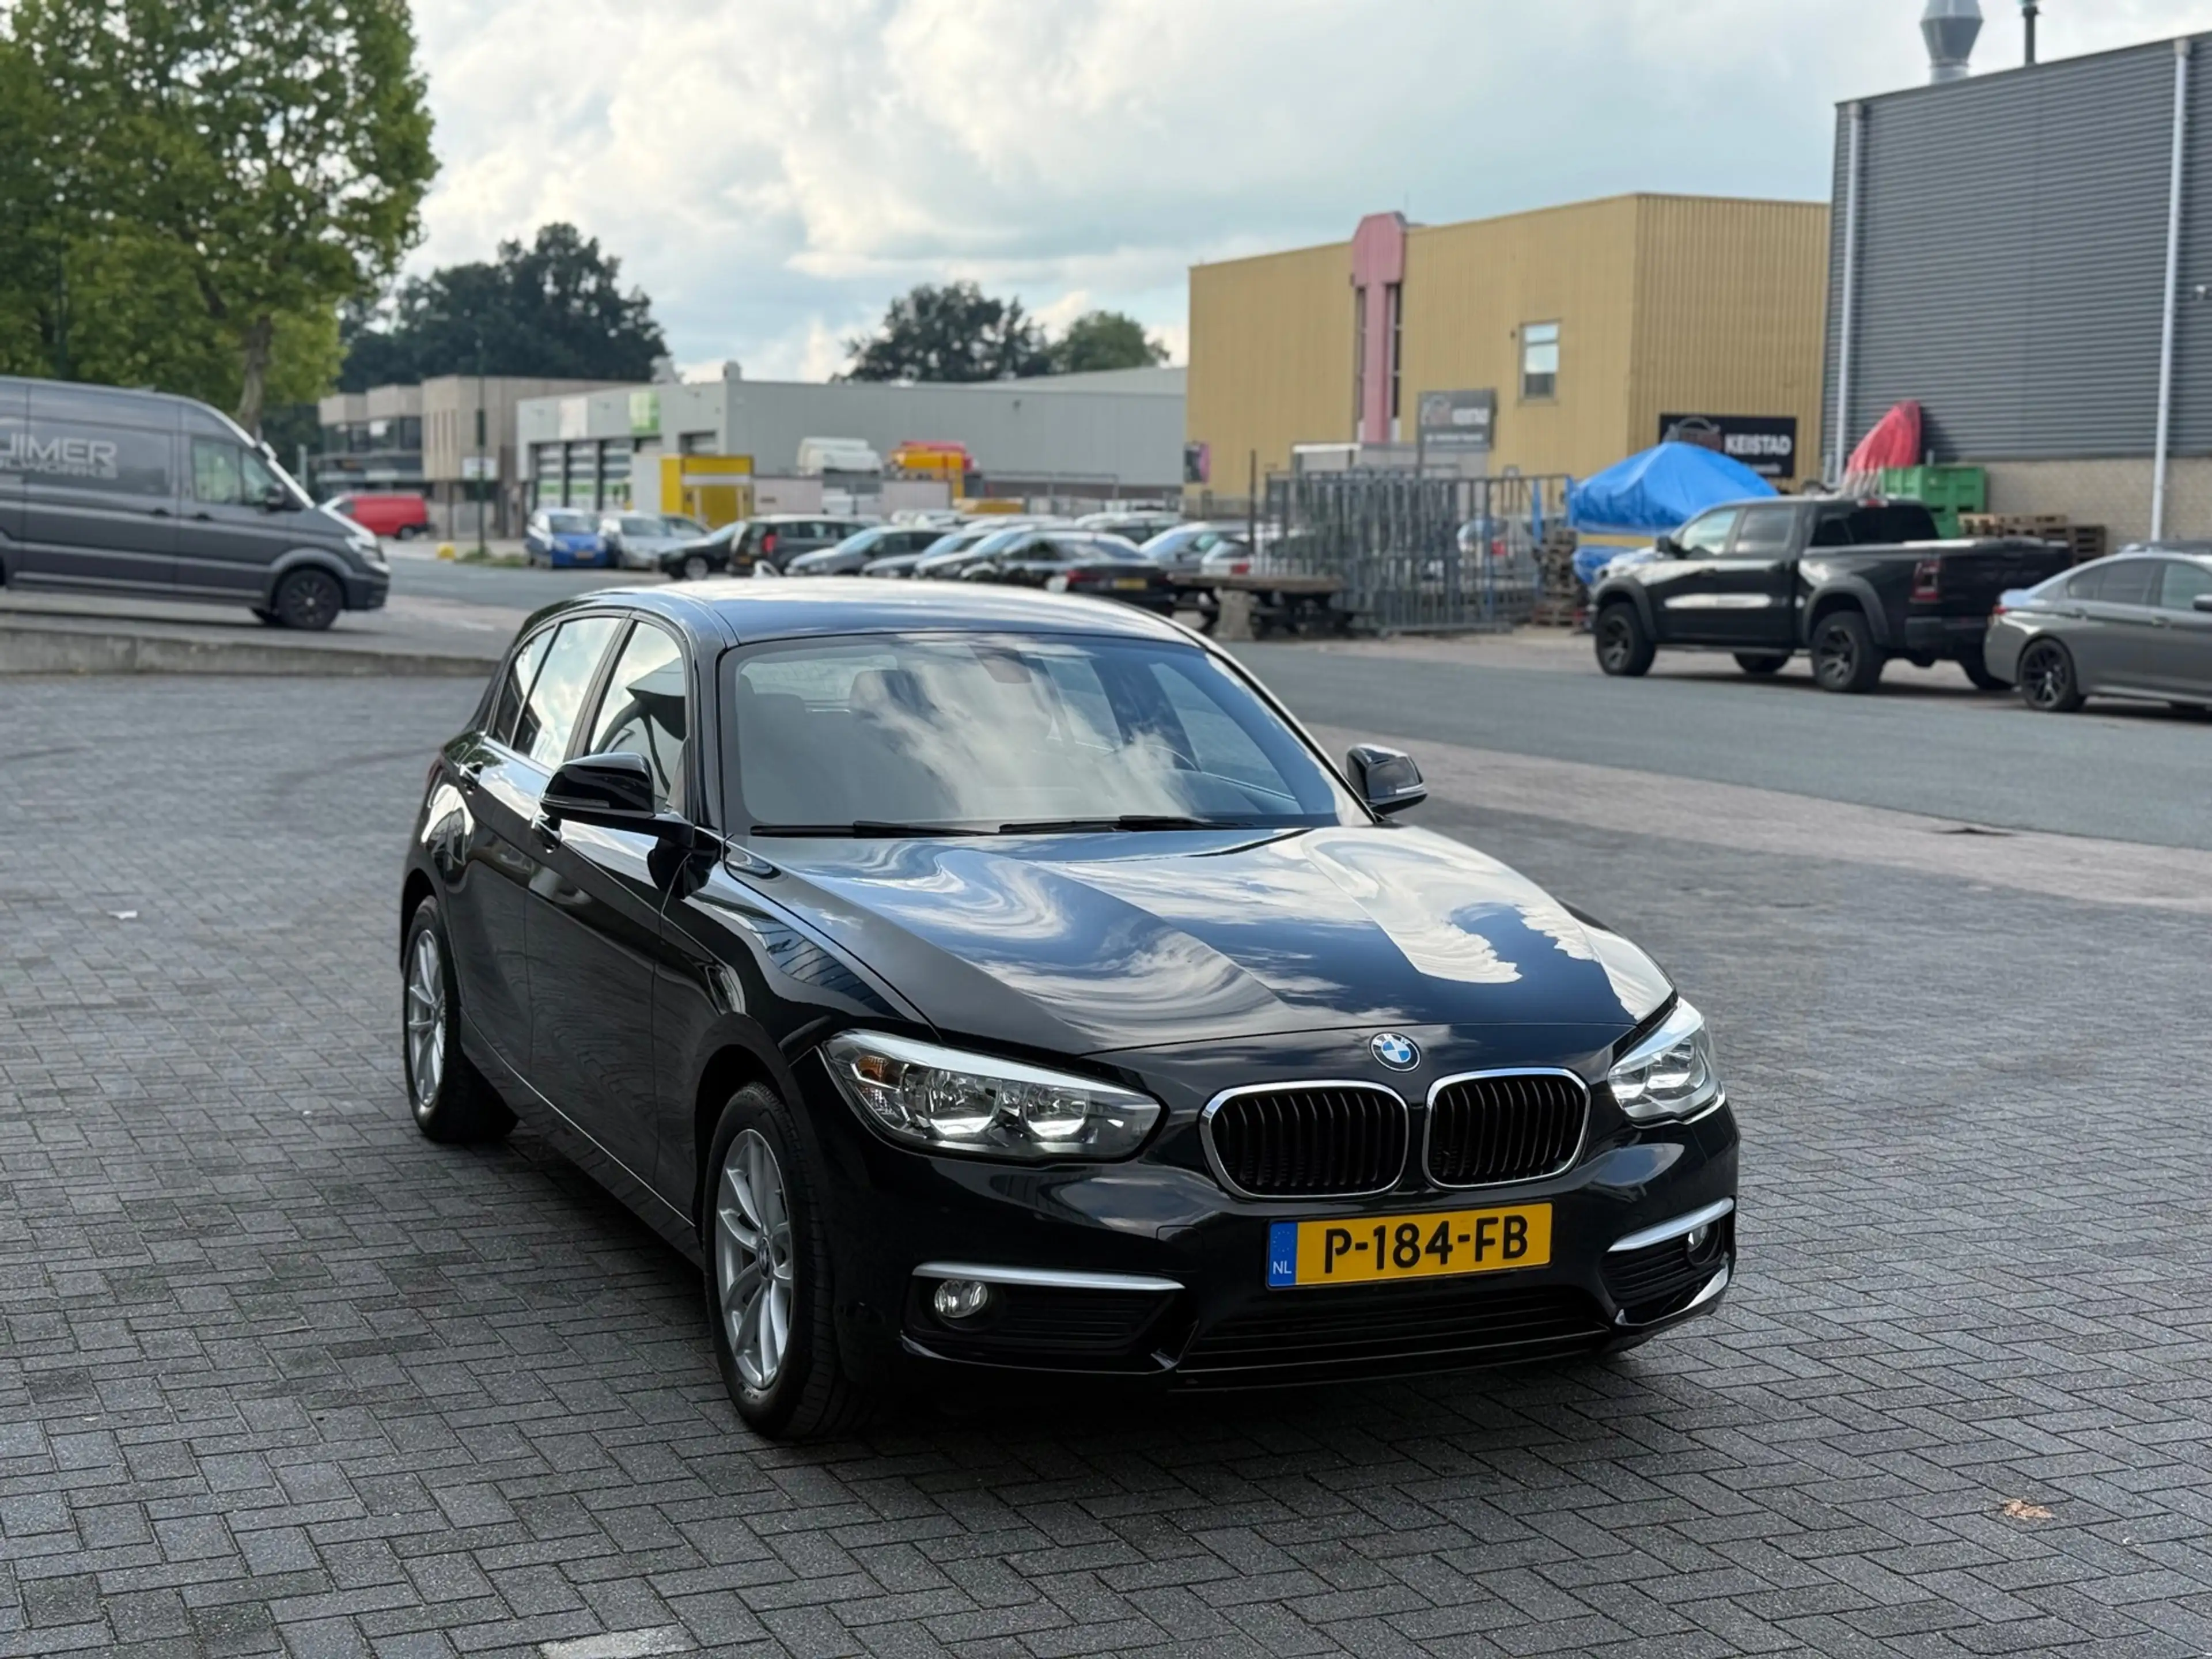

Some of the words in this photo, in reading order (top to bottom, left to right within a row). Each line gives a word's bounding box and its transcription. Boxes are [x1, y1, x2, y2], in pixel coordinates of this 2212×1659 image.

[1724, 434, 1792, 456] KEISTAD
[1324, 1214, 1528, 1274] P-184-FB
[1272, 1260, 1292, 1275] NL
